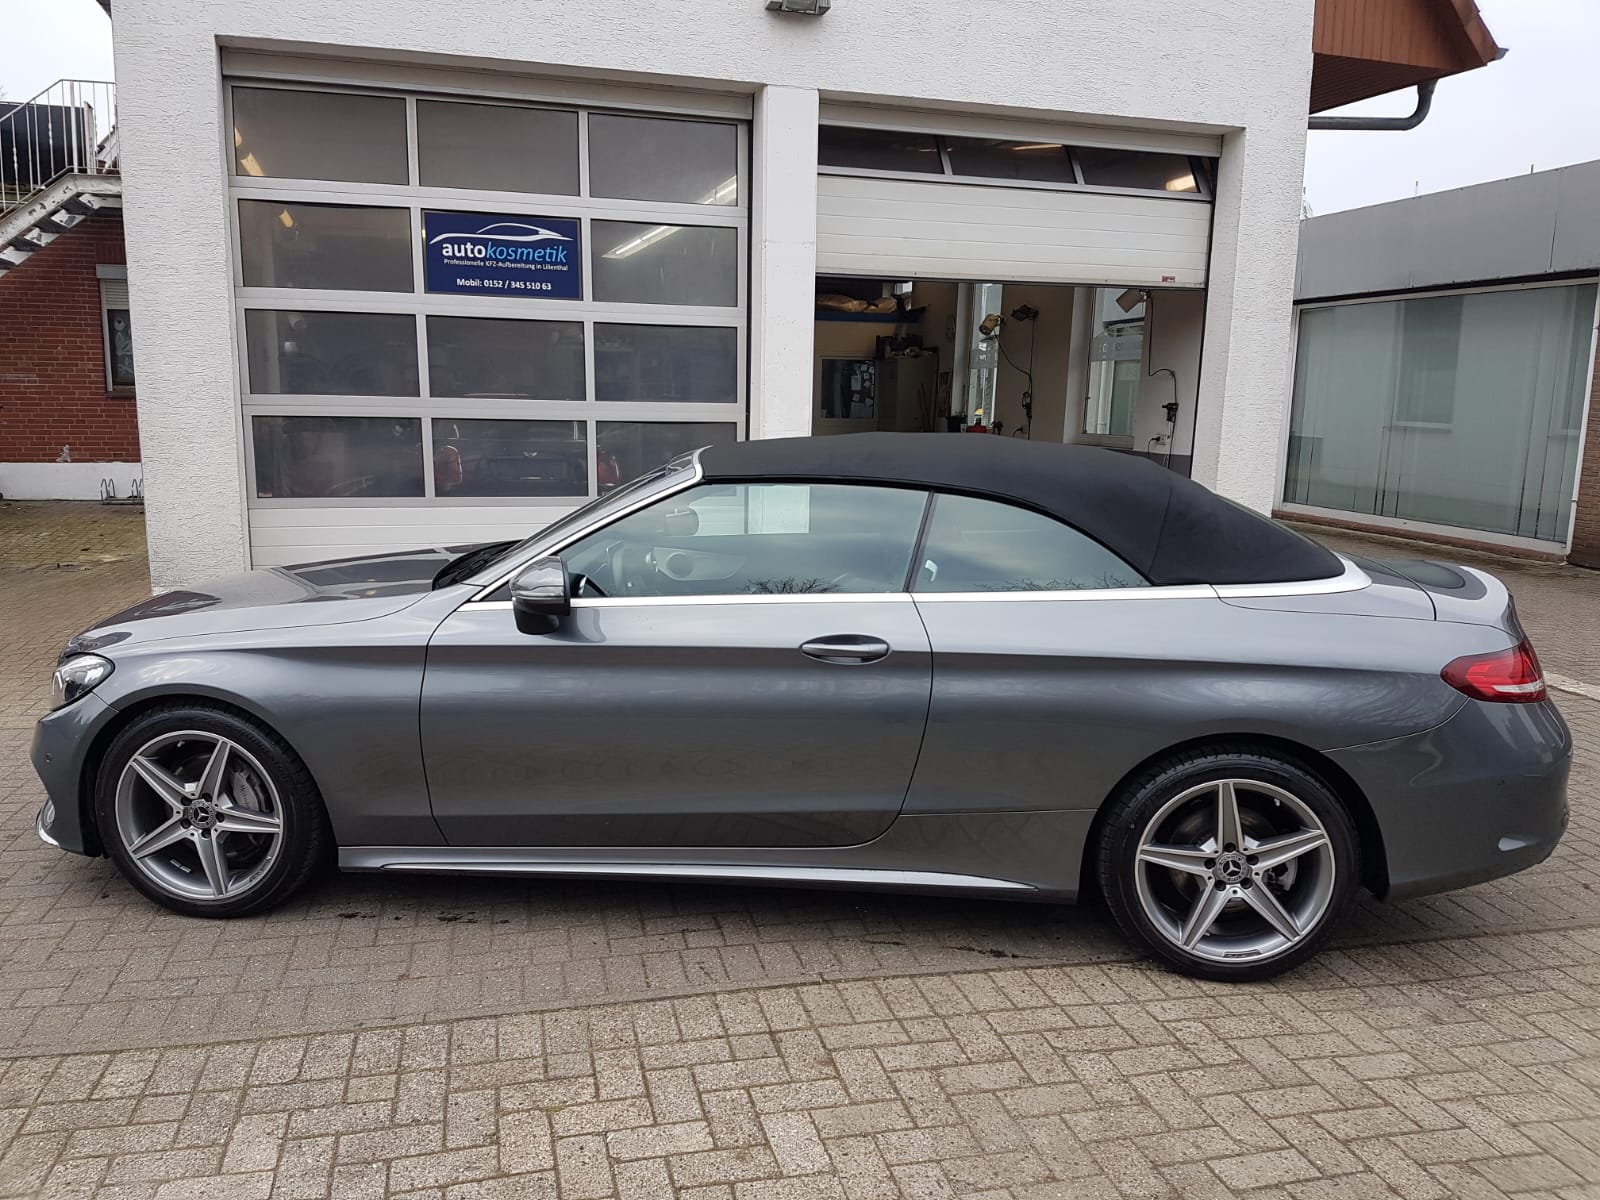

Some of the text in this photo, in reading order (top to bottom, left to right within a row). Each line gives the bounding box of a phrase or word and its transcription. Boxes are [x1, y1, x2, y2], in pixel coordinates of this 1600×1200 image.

[442, 241, 567, 263] autokosmetik
[444, 258, 484, 267] Professionelle
[485, 261, 535, 271] KFZ-Aufbereitung
[457, 278, 552, 290] Mobil: 0152 / 345 510 63
